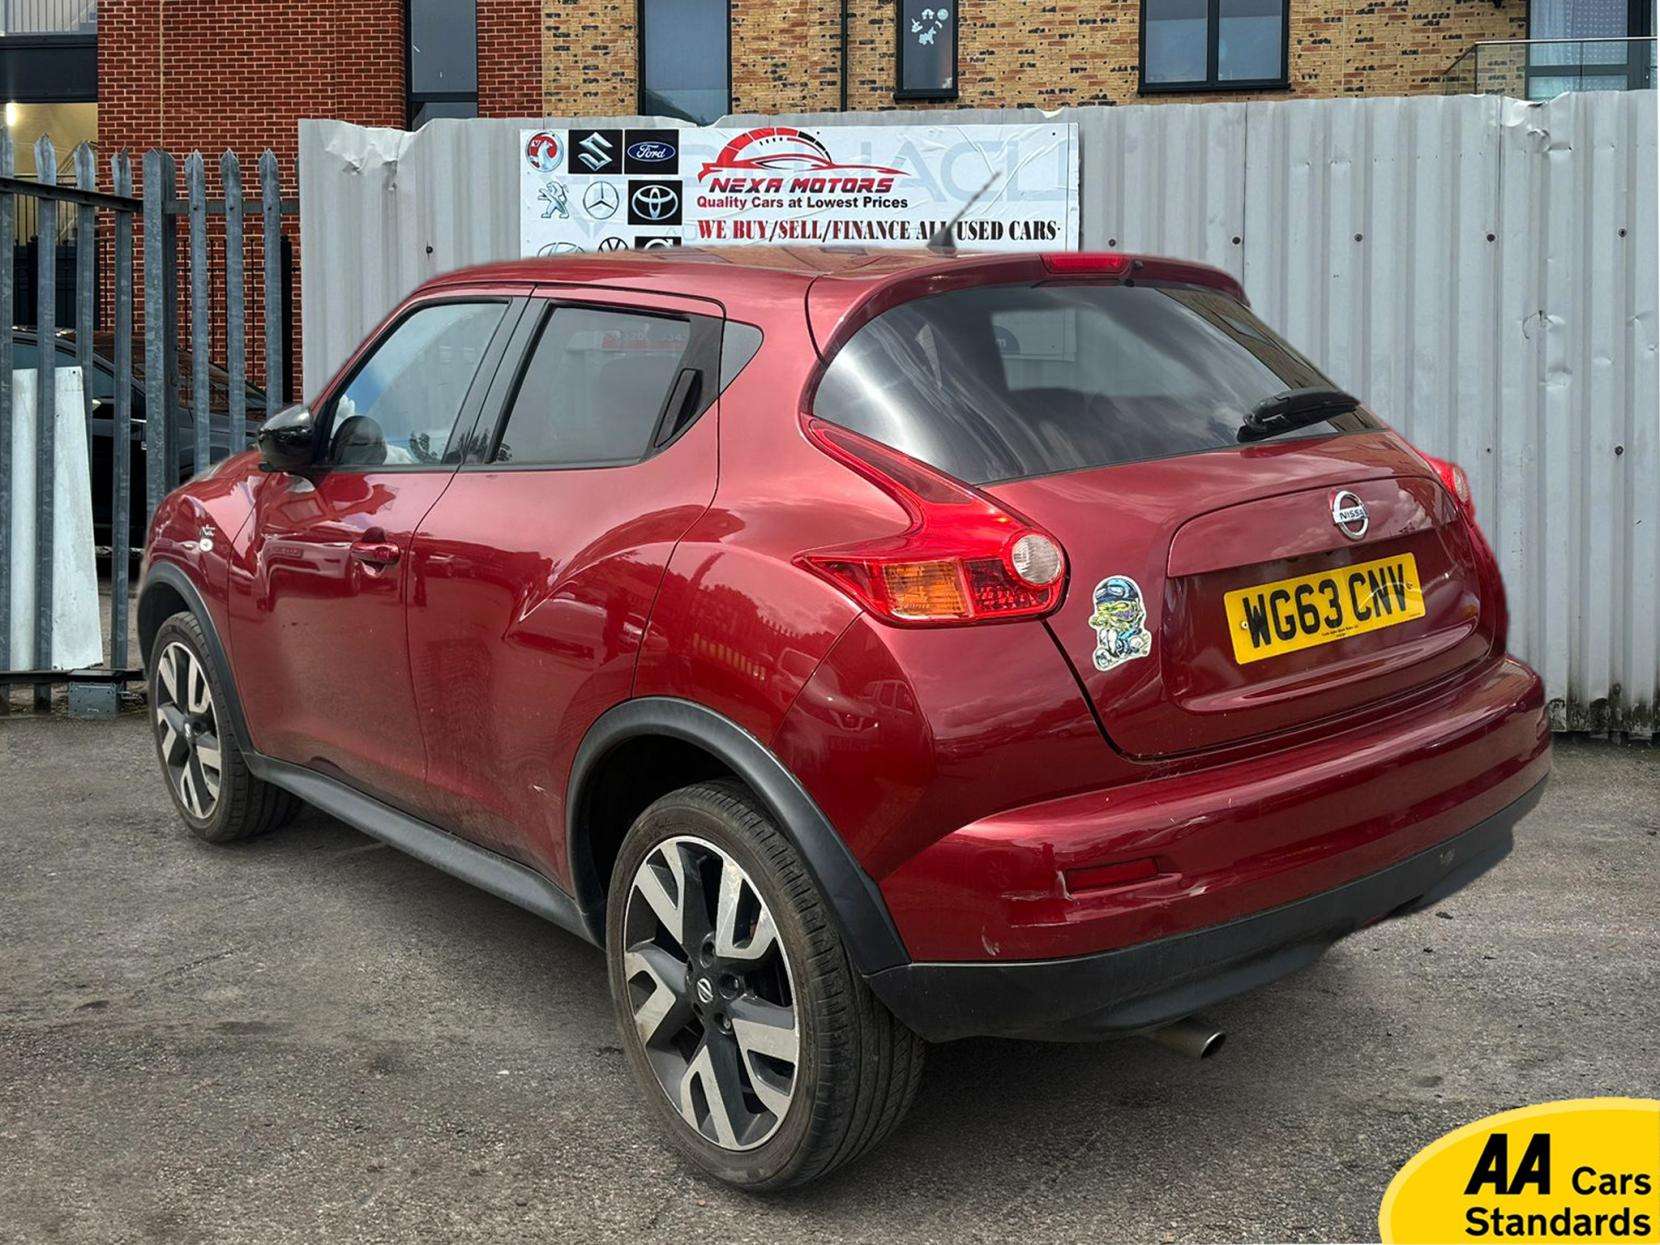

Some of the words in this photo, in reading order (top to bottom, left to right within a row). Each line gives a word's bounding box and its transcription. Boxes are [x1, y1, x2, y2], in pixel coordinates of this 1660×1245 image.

[636, 144, 666, 159] Ford
[709, 177, 784, 194] NEXA
[789, 177, 894, 194] MOTORS
[697, 195, 748, 209] Quality
[751, 196, 784, 208] Cars
[788, 196, 802, 208] at
[807, 196, 859, 208] Lowest
[863, 196, 908, 208] Prices
[698, 219, 727, 240] WE
[956, 220, 1003, 241] USED
[1009, 220, 1057, 241] CARS
[1243, 579, 1342, 648] WG63
[1349, 564, 1406, 621] CNV
